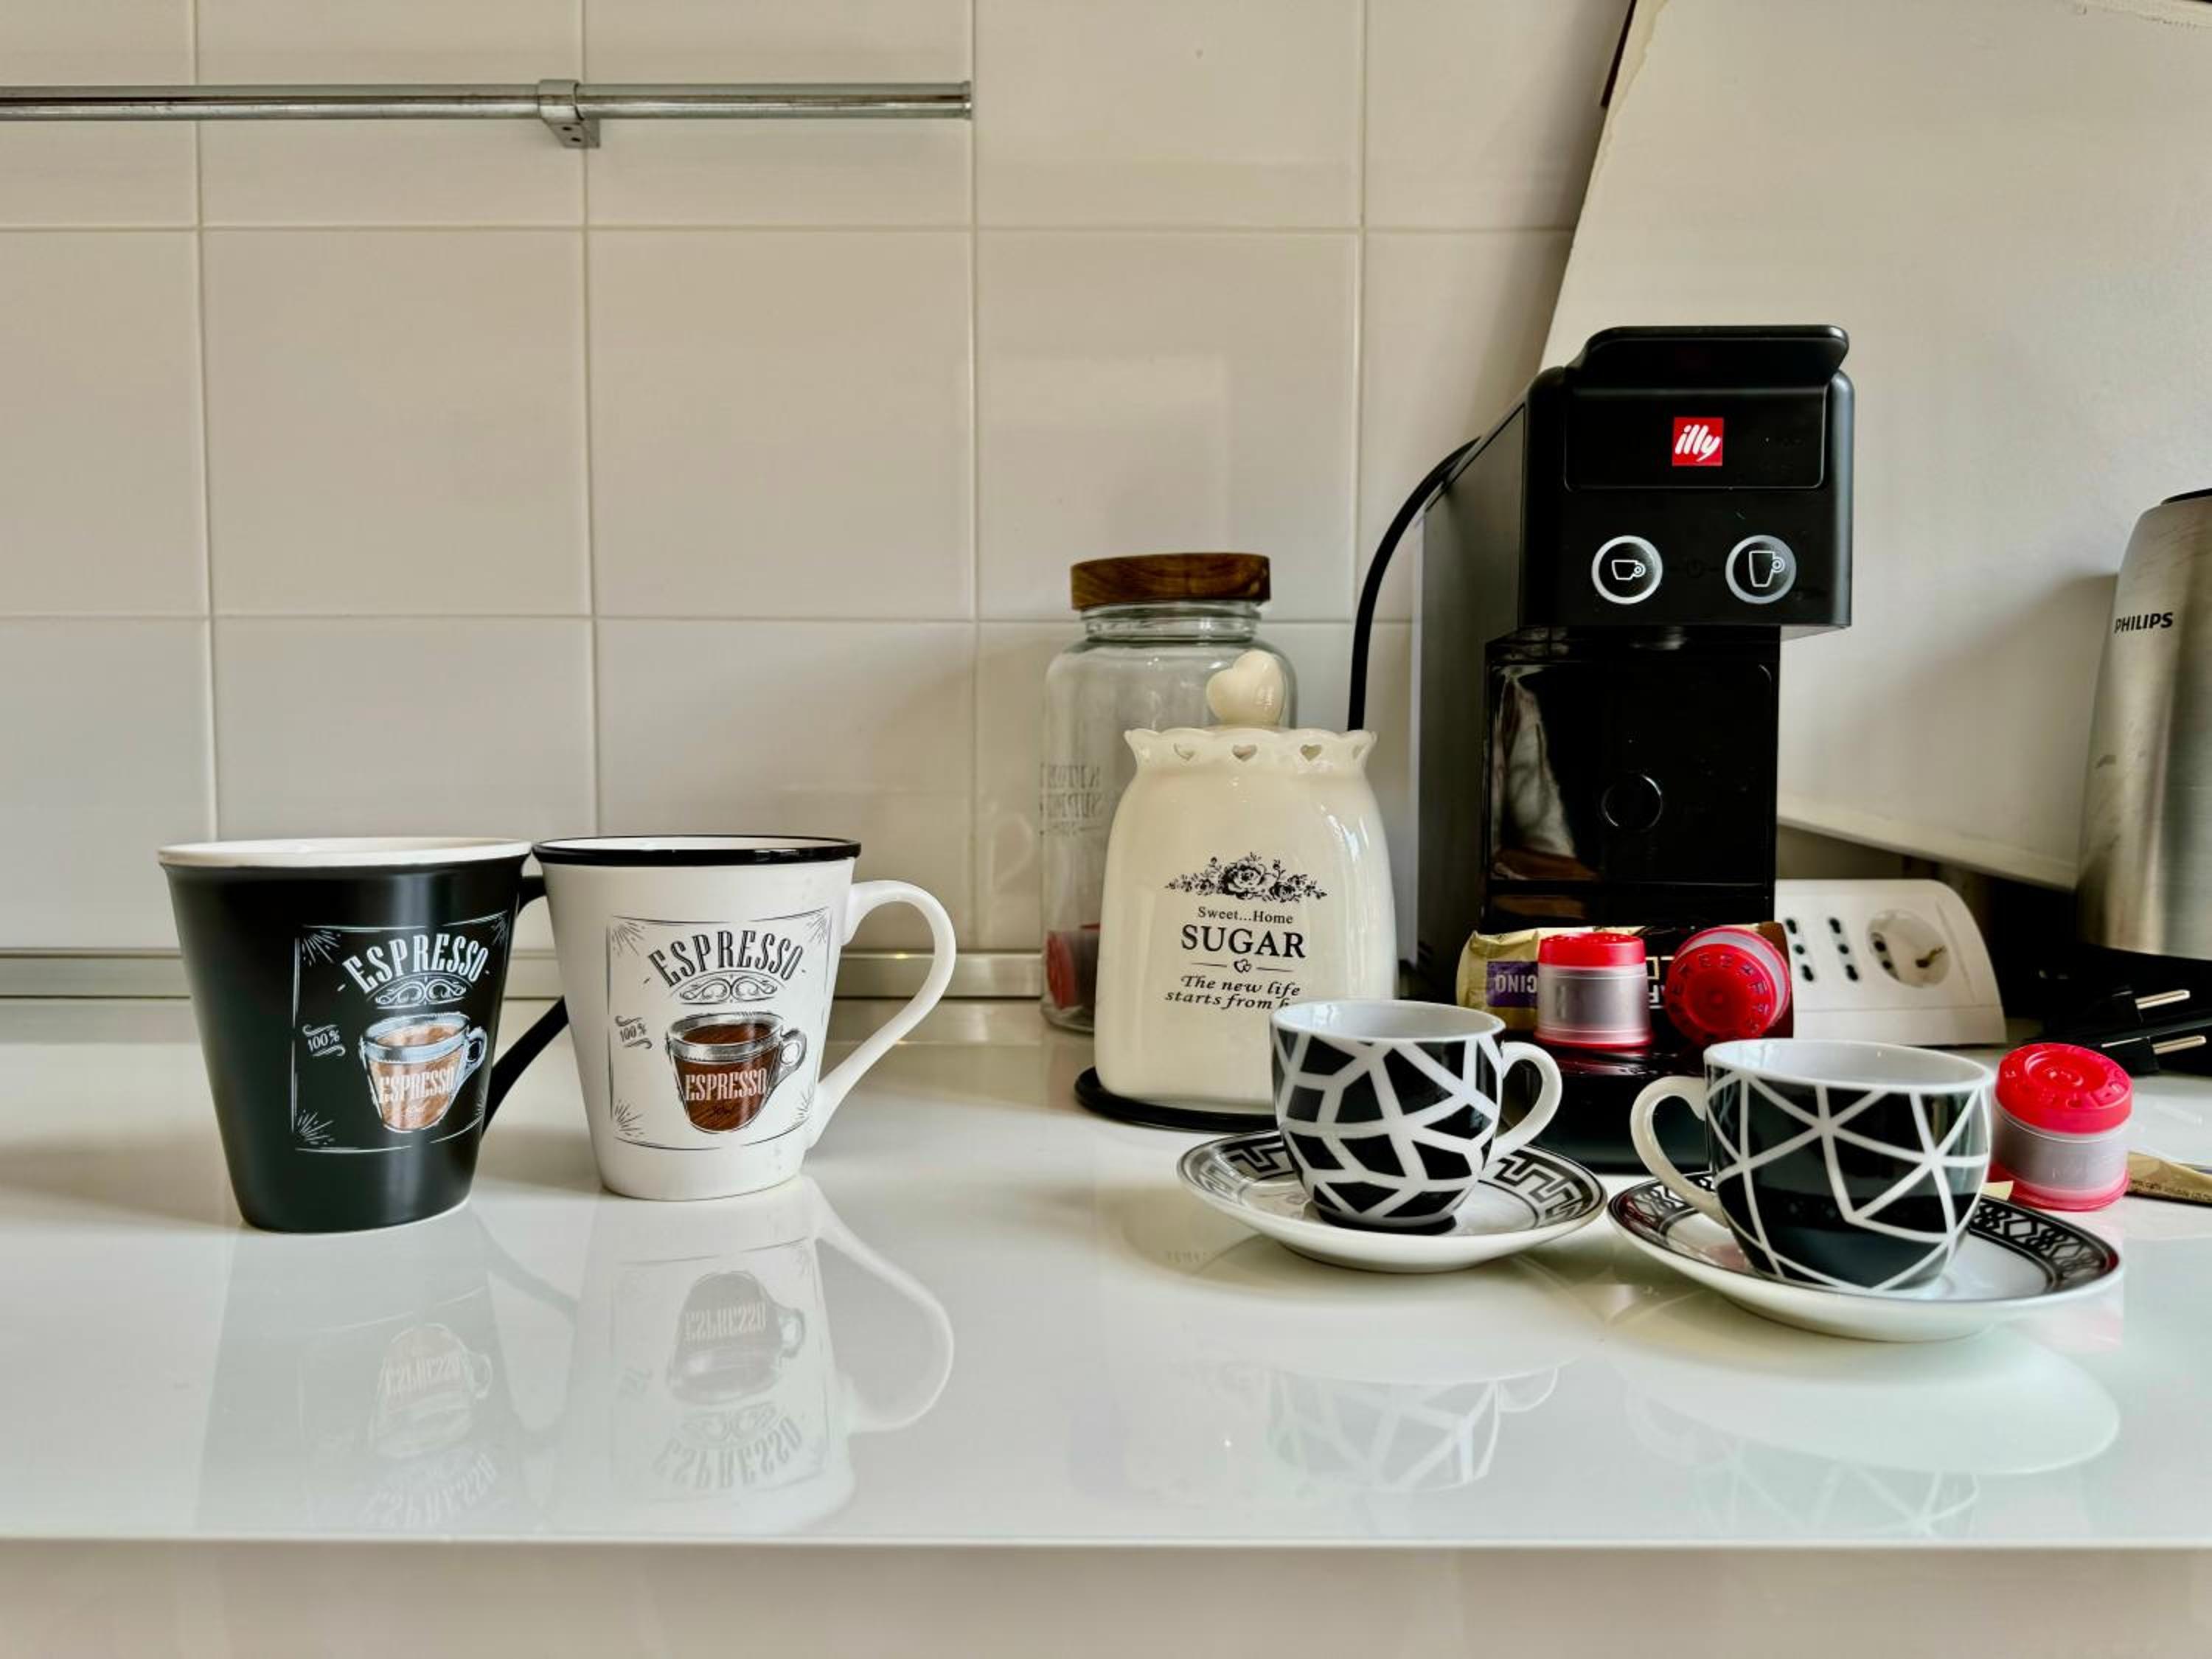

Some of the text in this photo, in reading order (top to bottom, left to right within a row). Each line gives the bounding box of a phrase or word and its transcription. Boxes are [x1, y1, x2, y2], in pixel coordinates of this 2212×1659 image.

[1674, 424, 1722, 462] illy
[2114, 612, 2174, 633] PHILIPS
[1180, 924, 1306, 958] SUGAR
[341, 933, 490, 995] ESPRESSO
[647, 929, 804, 988] ESPRESSO
[1164, 991, 1222, 1006] starts
[1221, 993, 1273, 1010] from
[1180, 975, 1301, 999] The new life
[307, 1029, 341, 1052] 100%
[620, 1023, 647, 1043] 100%
[378, 1067, 456, 1104] ESPRESSO
[684, 1068, 768, 1102] ESPRESSO
